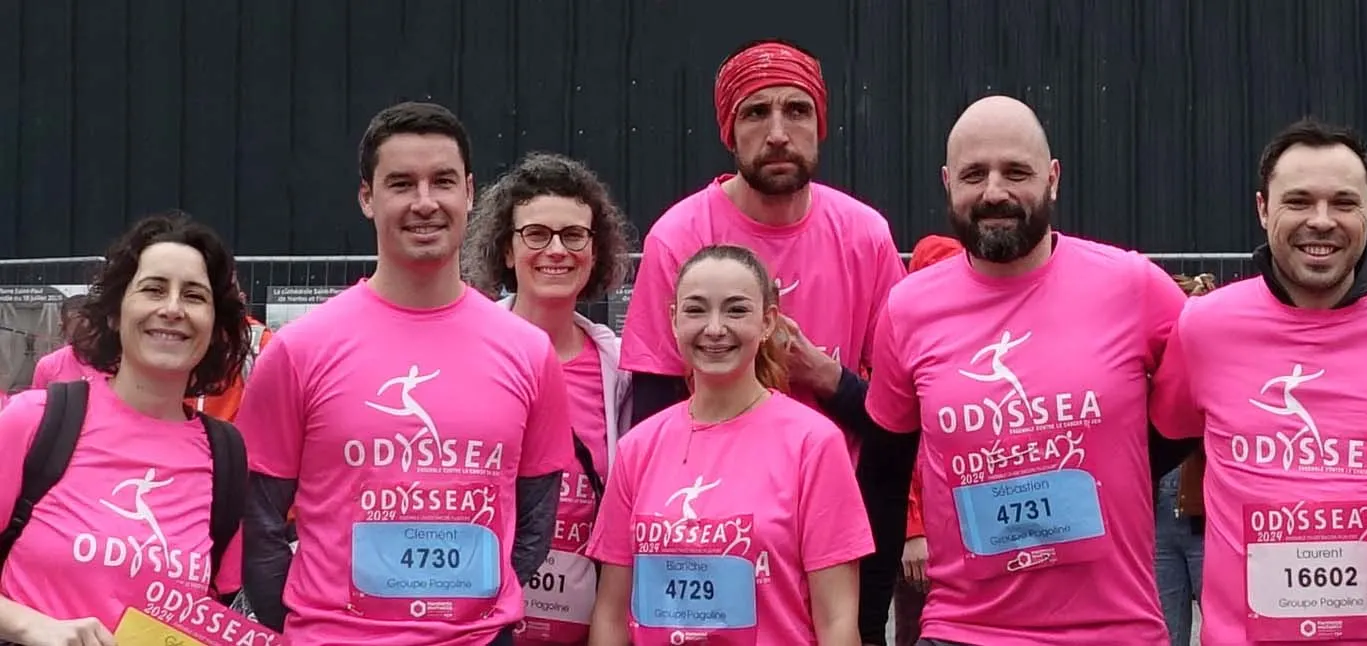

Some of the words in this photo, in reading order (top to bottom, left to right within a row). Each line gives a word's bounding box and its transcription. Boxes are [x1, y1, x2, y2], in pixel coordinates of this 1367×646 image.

[938, 388, 1101, 435] ODYSSEA
[344, 427, 504, 472] ODYSSEA
[952, 439, 1060, 475] ODYSSEA
[960, 472, 985, 485] 2024
[361, 481, 475, 514] ODYSSEA
[366, 511, 396, 521] 2024
[997, 497, 1052, 524] 4731
[1251, 501, 1363, 535] ODYSSEA
[636, 520, 727, 546] ODYSSEA
[1257, 531, 1282, 542] 2024
[401, 548, 460, 568] 4730
[1296, 547, 1343, 559] Laurent
[529, 573, 566, 593] 601
[1284, 567, 1358, 588] 16602
[666, 580, 714, 600] 4729
[144, 603, 175, 622] 2024
